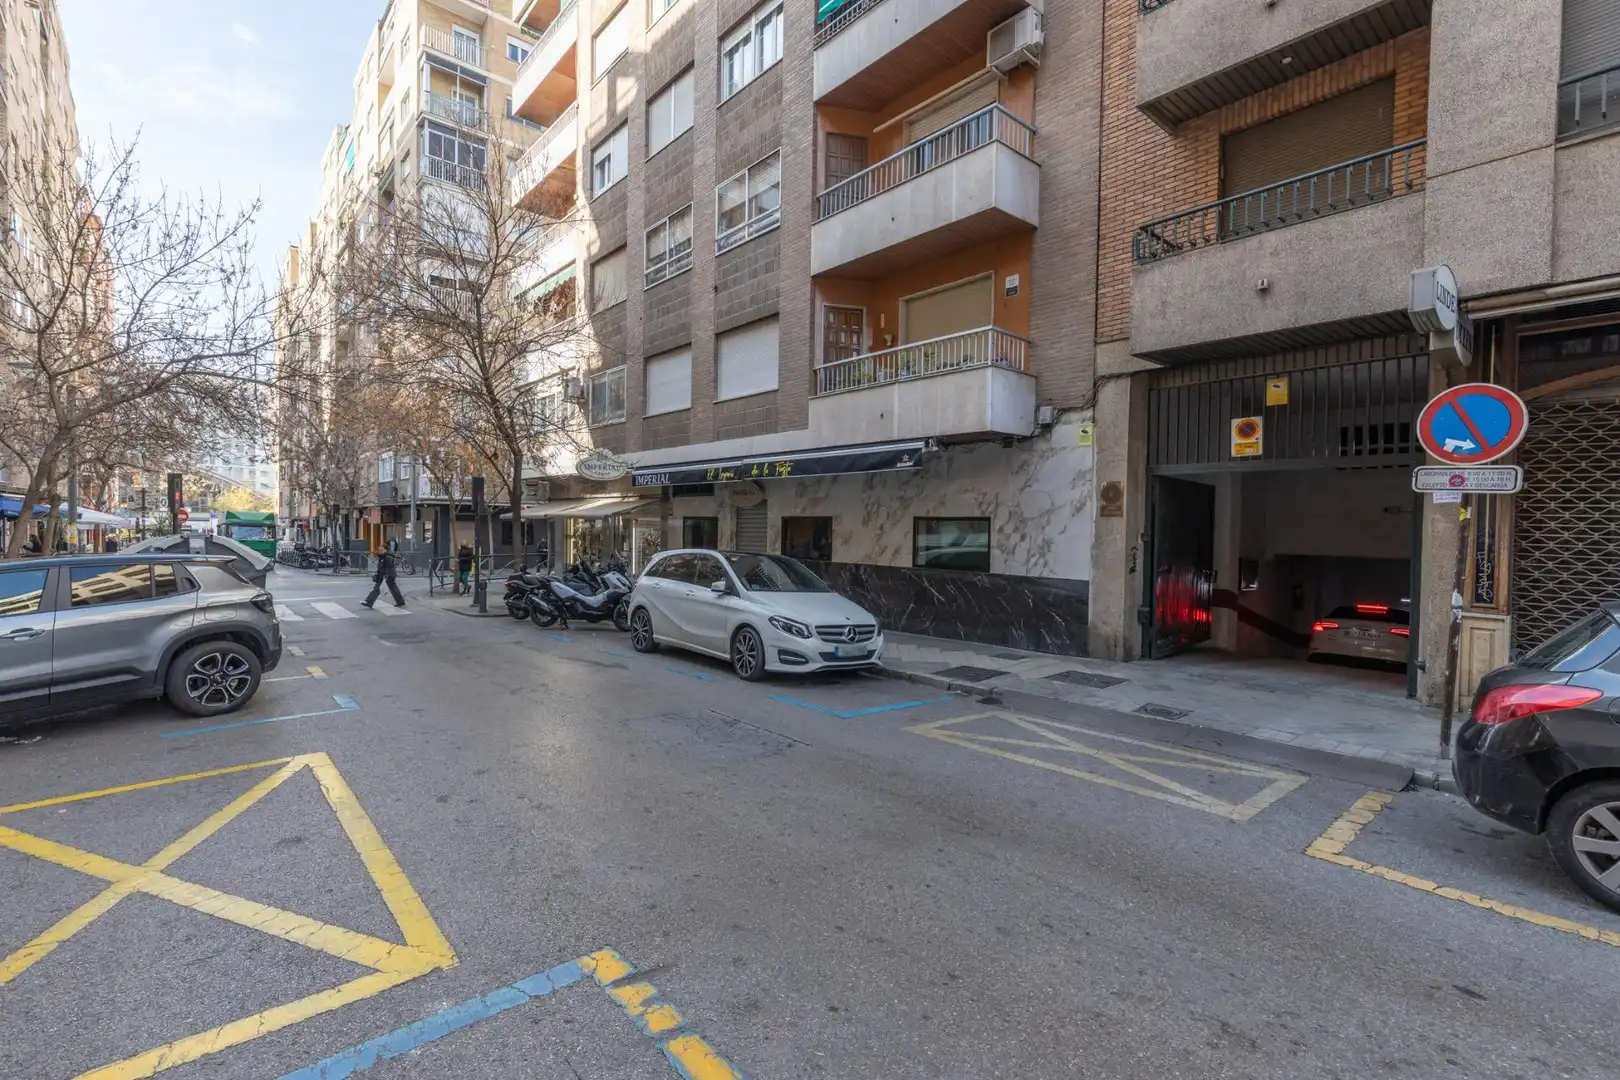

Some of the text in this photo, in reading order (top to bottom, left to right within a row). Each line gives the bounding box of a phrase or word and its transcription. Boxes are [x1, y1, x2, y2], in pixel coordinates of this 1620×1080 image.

[1436, 281, 1456, 313] LINDE
[584, 463, 620, 471] IMPERIAL
[635, 473, 670, 485] IMPERIAL
